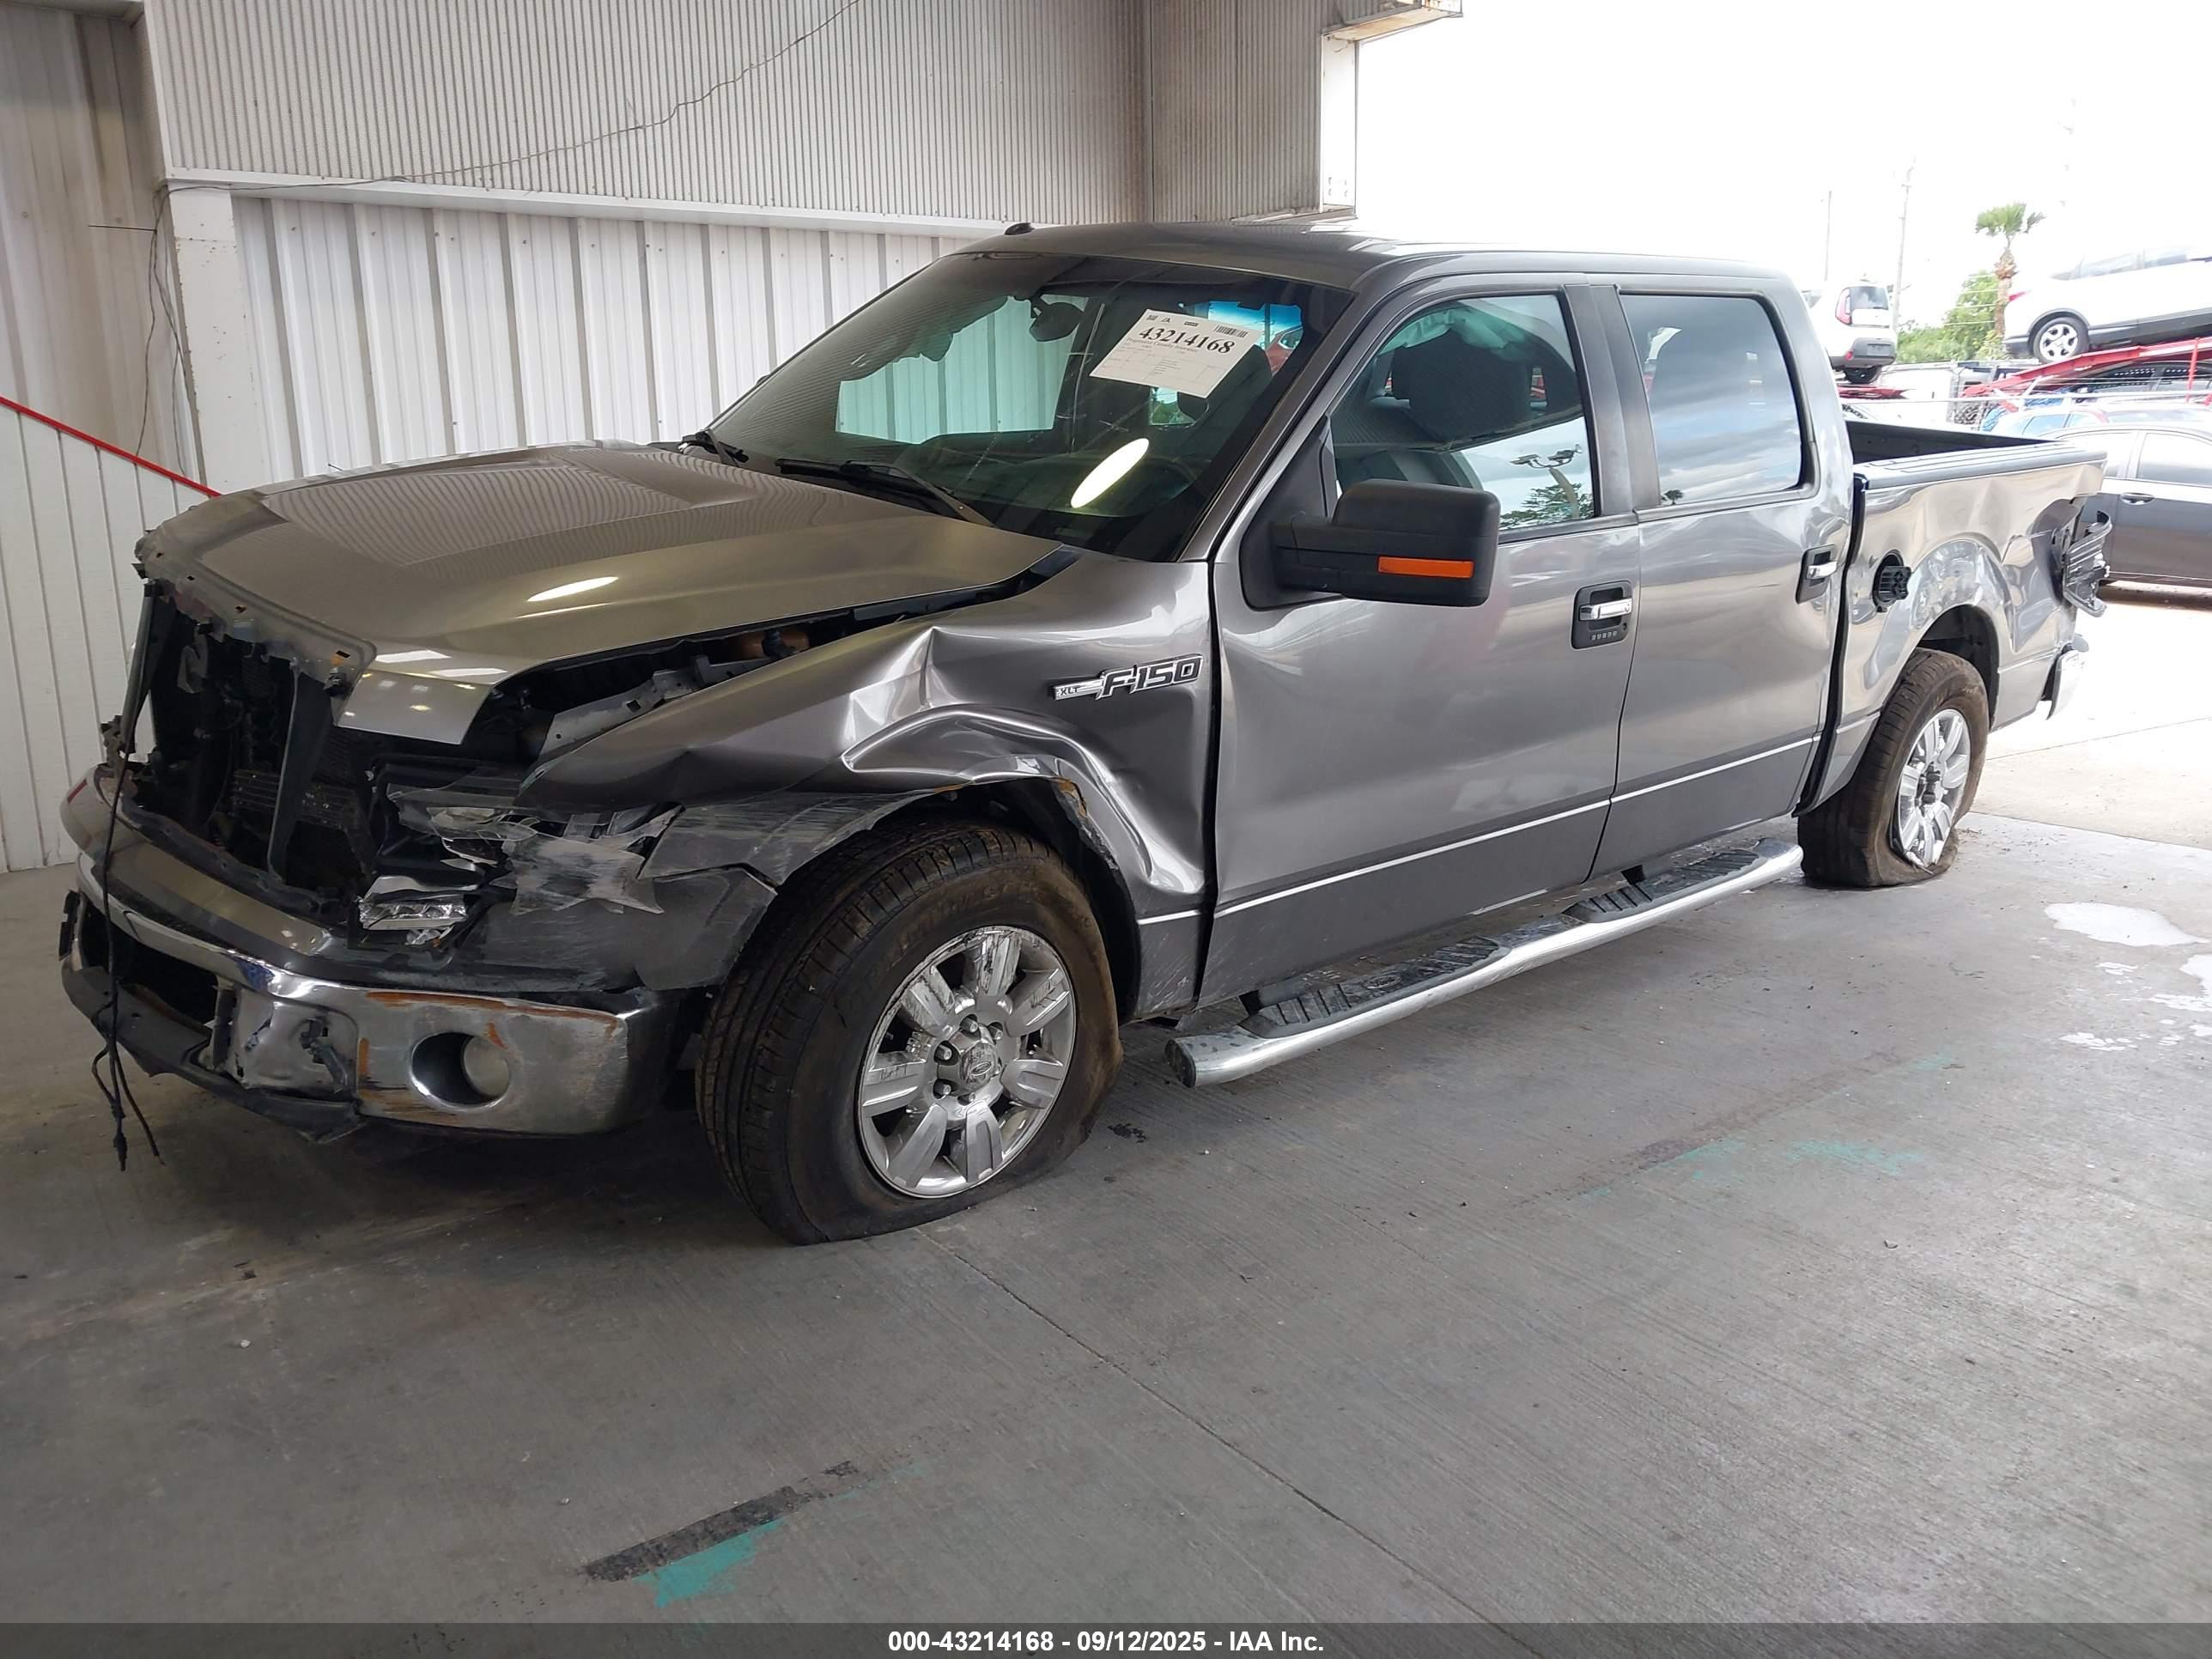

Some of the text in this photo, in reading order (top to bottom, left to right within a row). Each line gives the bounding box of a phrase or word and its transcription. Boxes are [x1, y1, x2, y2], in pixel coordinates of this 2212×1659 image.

[1139, 326, 1236, 354] 43214168
[1060, 655, 1203, 699] XLT F-150
